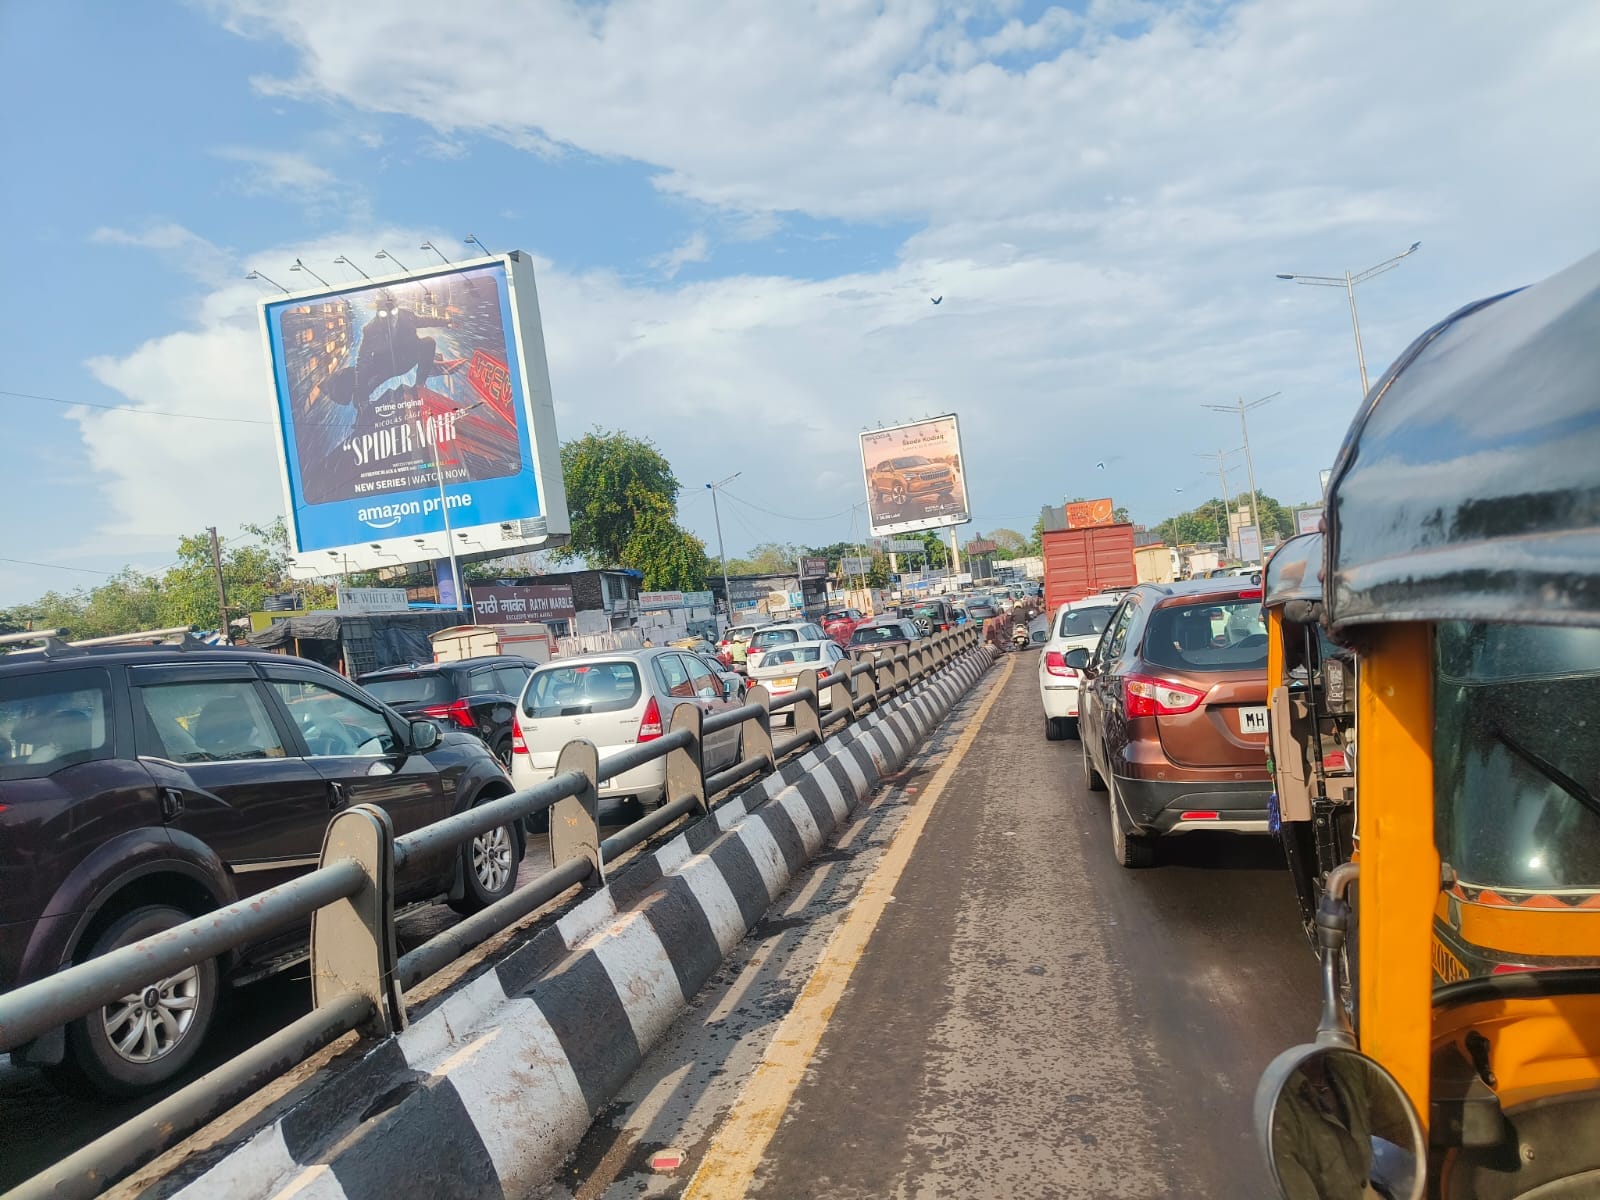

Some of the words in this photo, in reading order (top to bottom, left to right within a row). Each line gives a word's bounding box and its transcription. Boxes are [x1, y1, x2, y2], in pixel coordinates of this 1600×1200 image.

[375, 404, 396, 414] prime
[397, 398, 424, 410] original
[354, 483, 374, 493] NEW
[376, 478, 406, 489] SERIES
[445, 468, 467, 479] NOW
[358, 501, 420, 522] amazon
[360, 592, 389, 604] WHITE
[391, 592, 406, 603] ART
[476, 594, 498, 614] राठी
[530, 597, 549, 611] RATHI
[549, 596, 574, 610] MARBLE
[1246, 713, 1264, 727] MH
